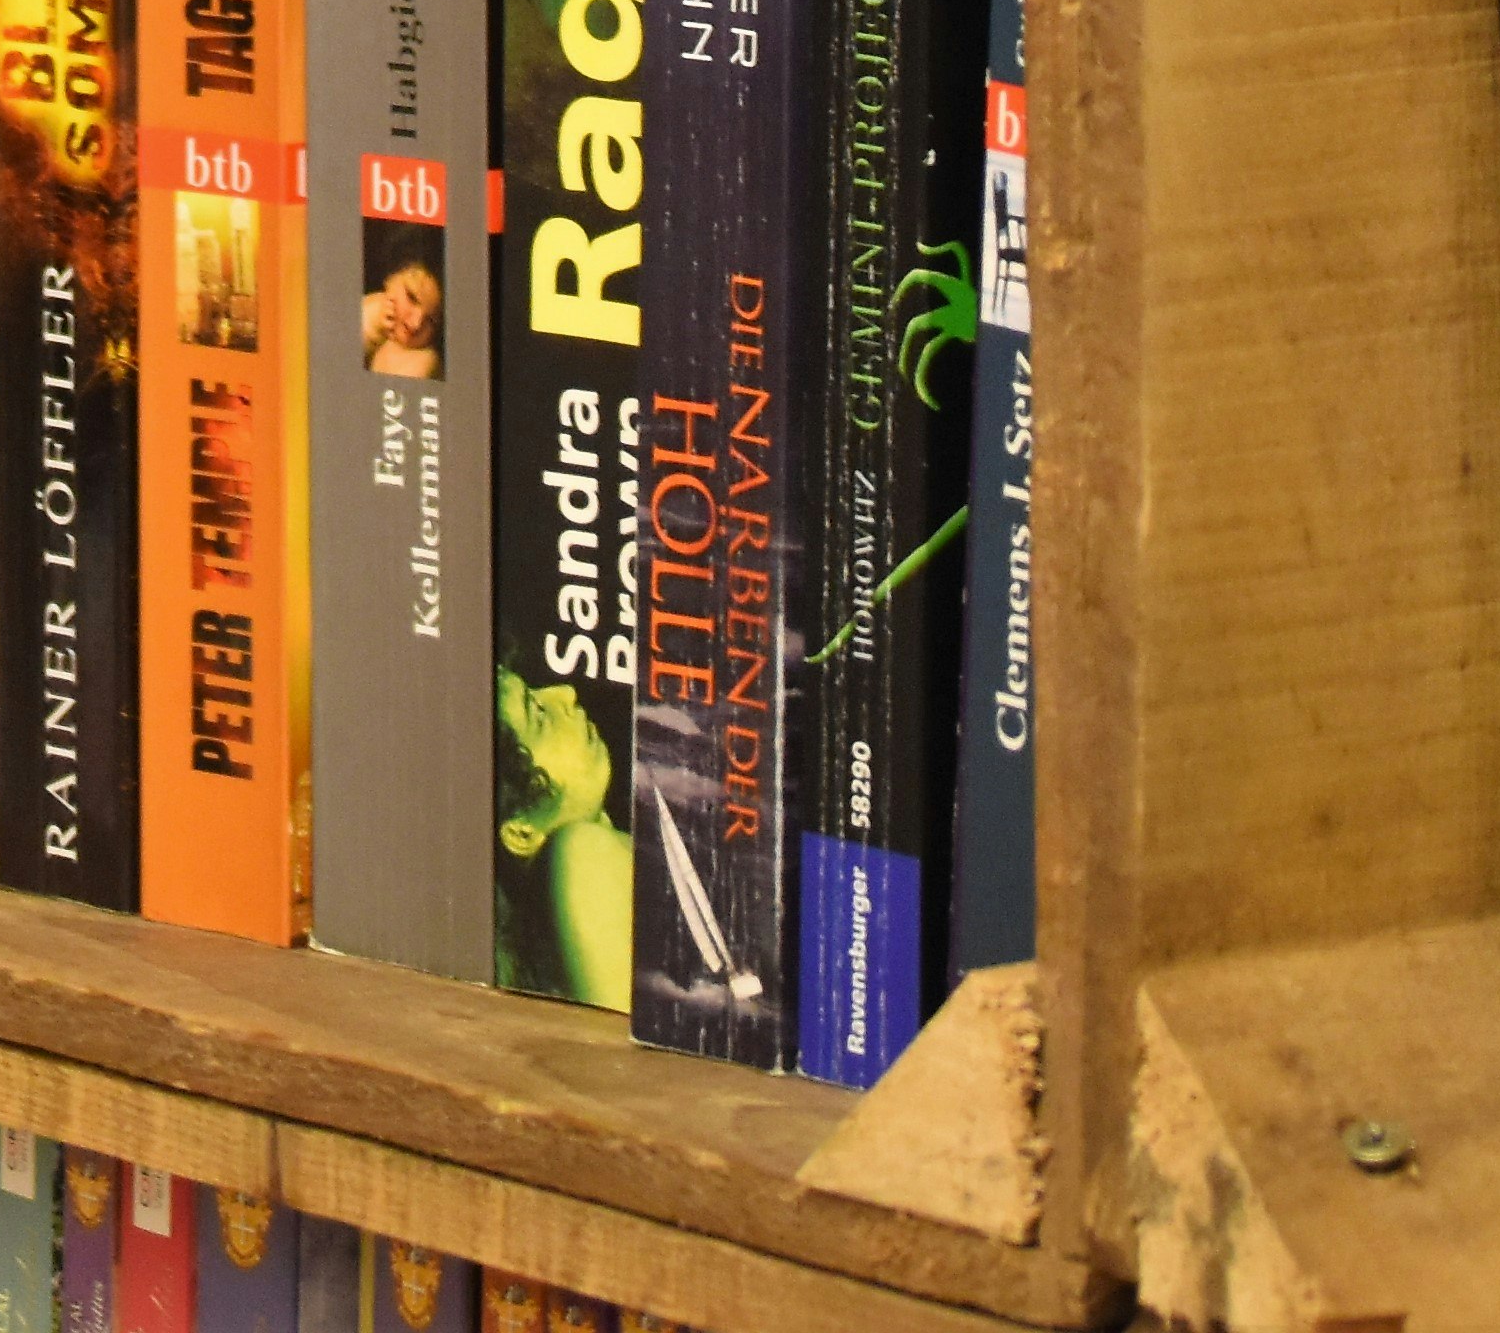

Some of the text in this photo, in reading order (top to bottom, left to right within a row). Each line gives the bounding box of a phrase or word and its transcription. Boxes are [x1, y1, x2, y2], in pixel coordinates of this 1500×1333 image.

[185, 138, 253, 194] btb
[370, 163, 441, 219] btb
[373, 388, 414, 487] Faye
[414, 396, 442, 639] Kellerman
[543, 388, 600, 681] Sandra
[648, 394, 716, 709] HÖLLE
[722, 272, 771, 843] DIE NARBEN DER
[34, 265, 79, 864] RAINER LÖFFLER
[190, 378, 255, 780] PETER TEMPLE
[847, 741, 872, 832] 58290
[845, 865, 871, 1058] Ravensburger
